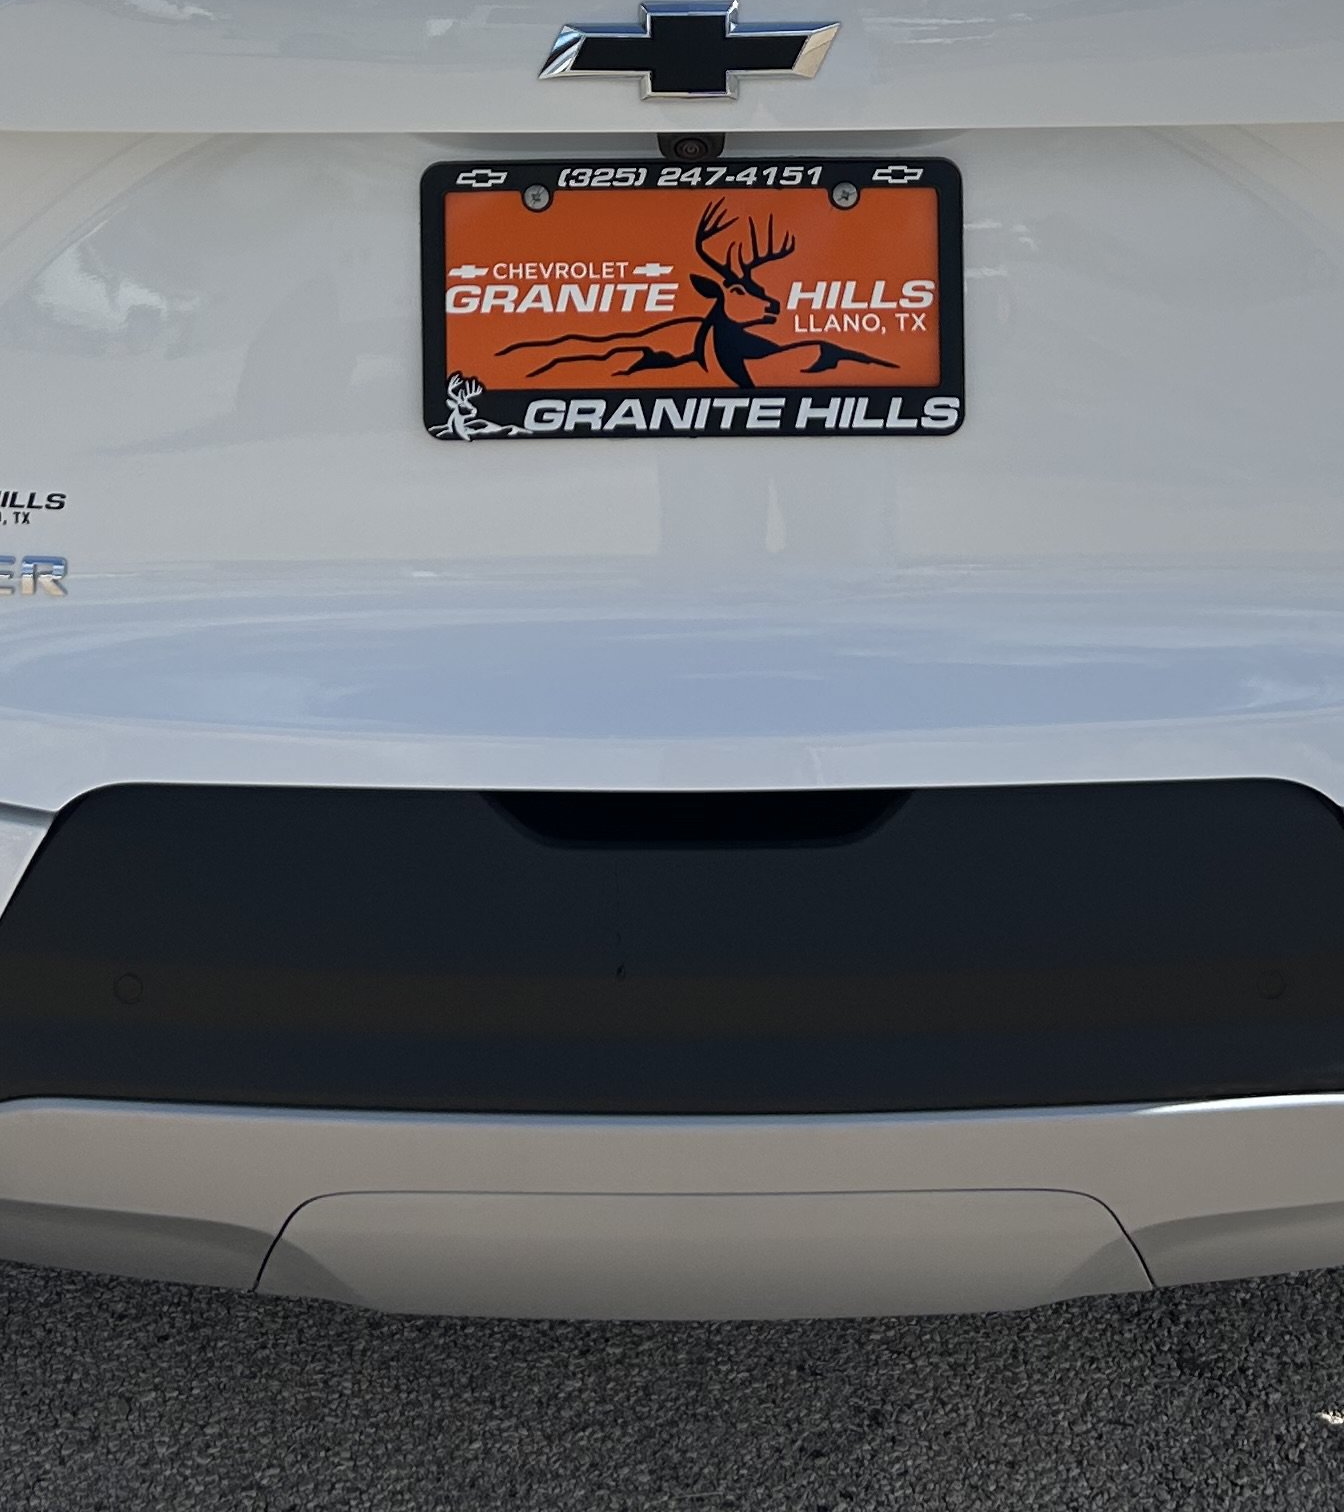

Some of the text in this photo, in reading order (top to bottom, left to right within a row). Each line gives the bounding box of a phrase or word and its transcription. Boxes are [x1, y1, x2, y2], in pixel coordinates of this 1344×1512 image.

[557, 167, 823, 188] (325) 247-4151
[493, 262, 628, 280] CHEVROLET
[445, 280, 935, 313] GRANITE HILLS
[794, 314, 927, 335] LLANO, TX
[524, 396, 961, 431] GRANITE HILLS
[13, 511, 31, 525] TX
